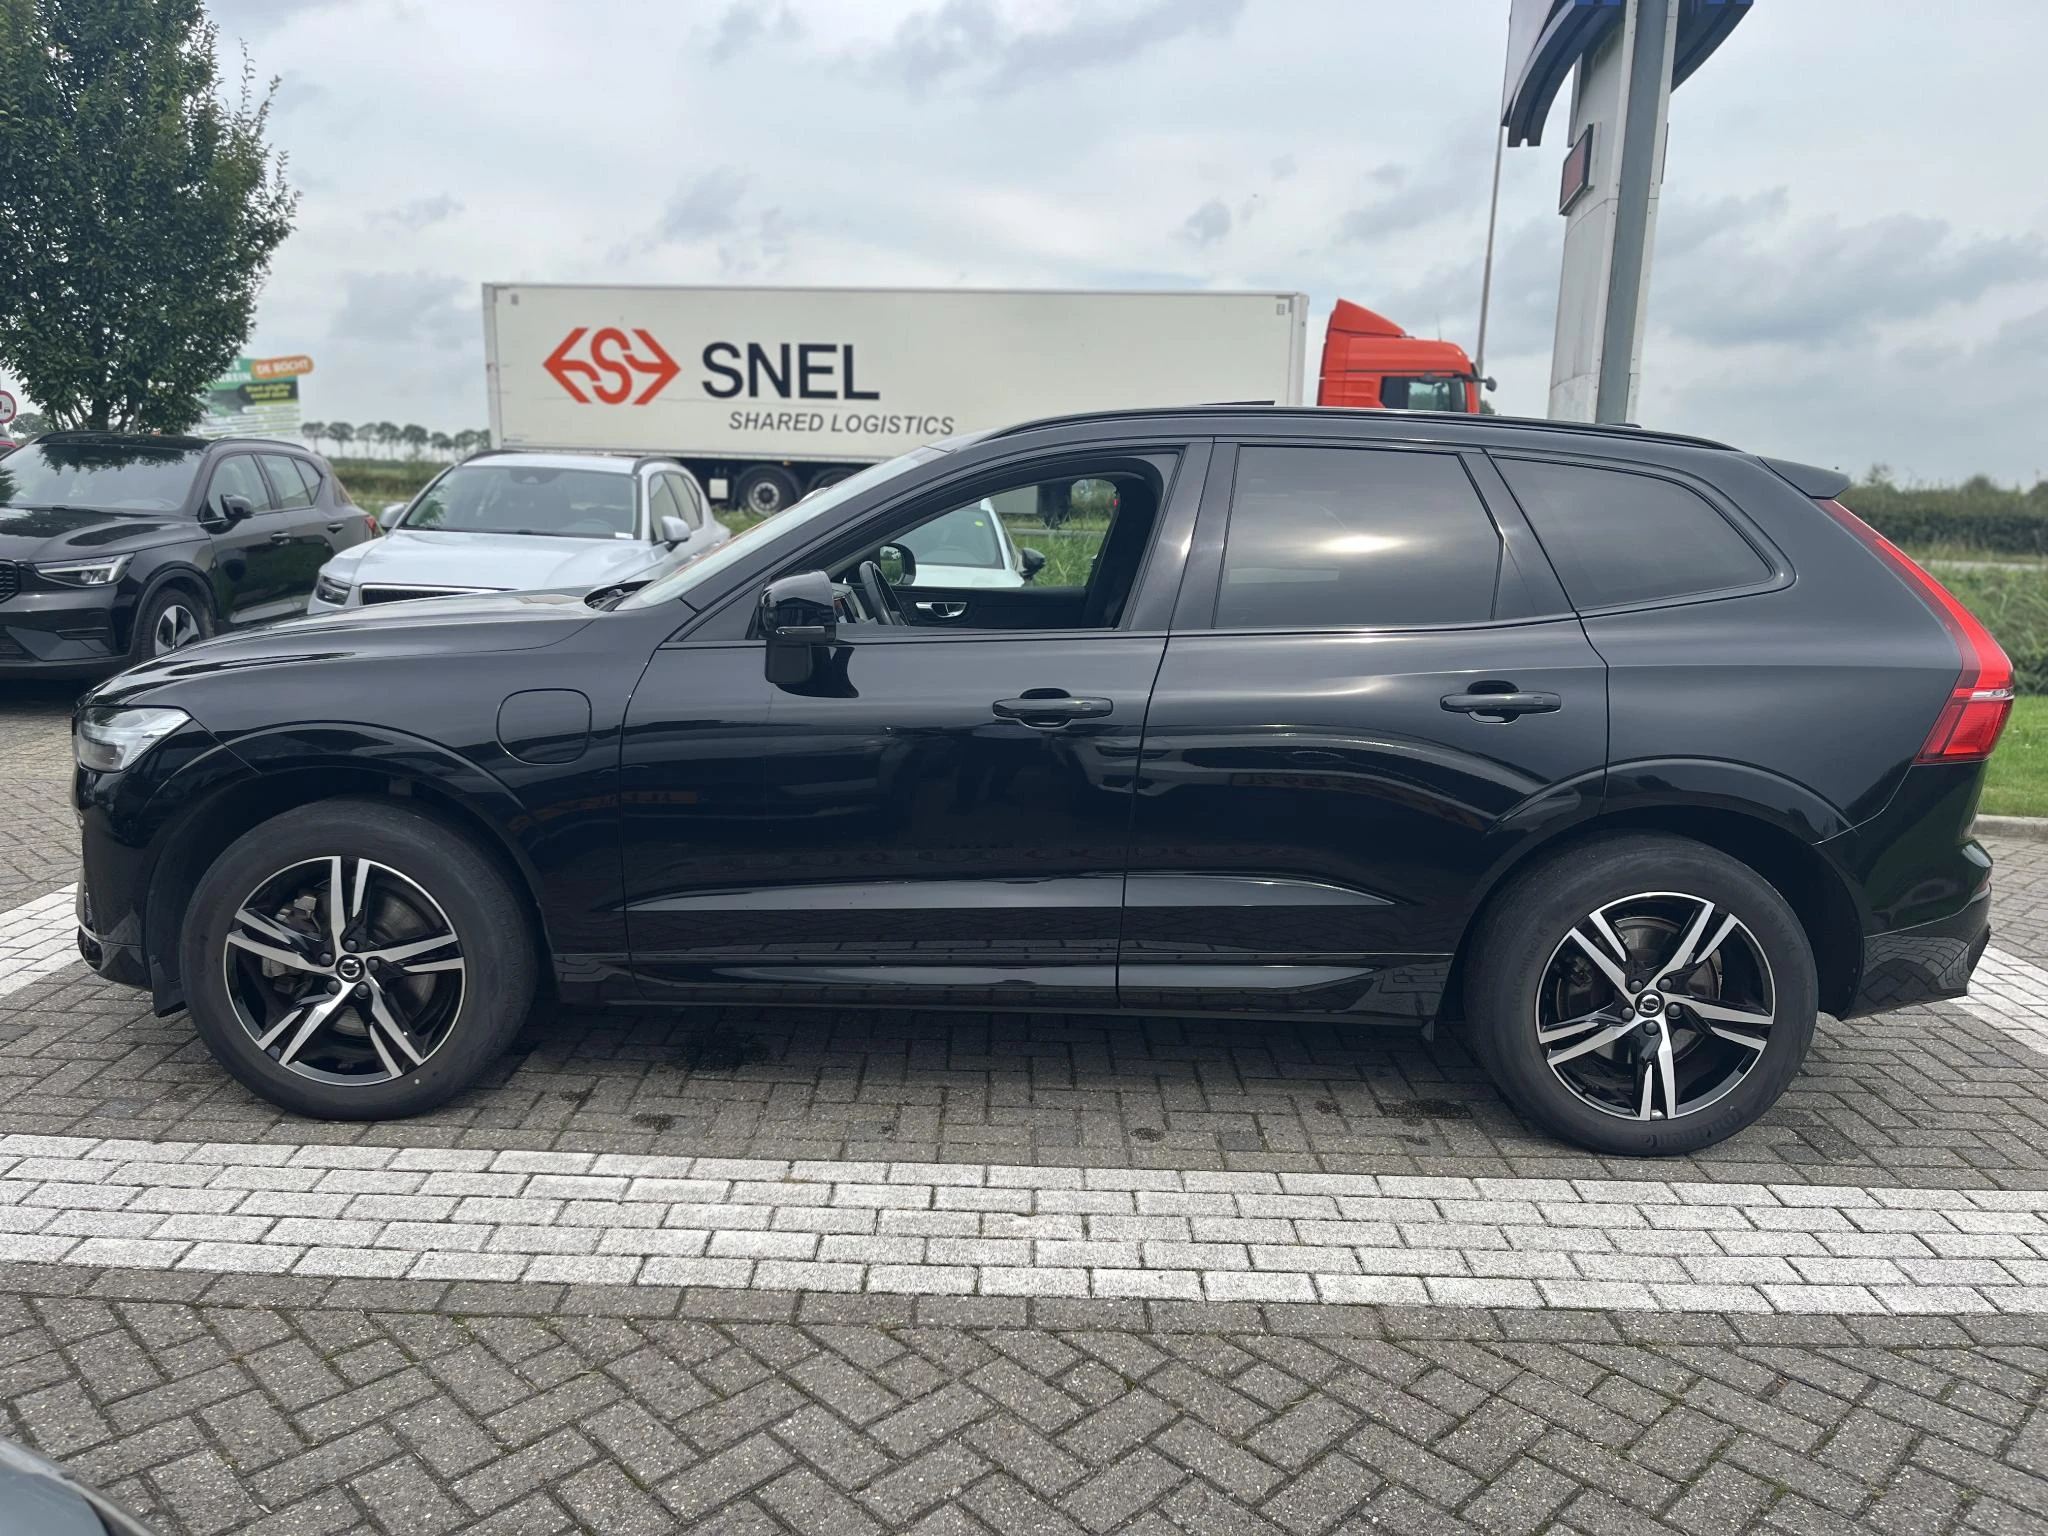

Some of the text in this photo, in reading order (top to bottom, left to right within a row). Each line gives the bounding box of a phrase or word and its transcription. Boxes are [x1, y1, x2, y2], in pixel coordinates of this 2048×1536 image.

[272, 360, 308, 373] BOCHT
[701, 342, 880, 401] SNEL
[728, 411, 955, 436] SHARED LOGISTICS
